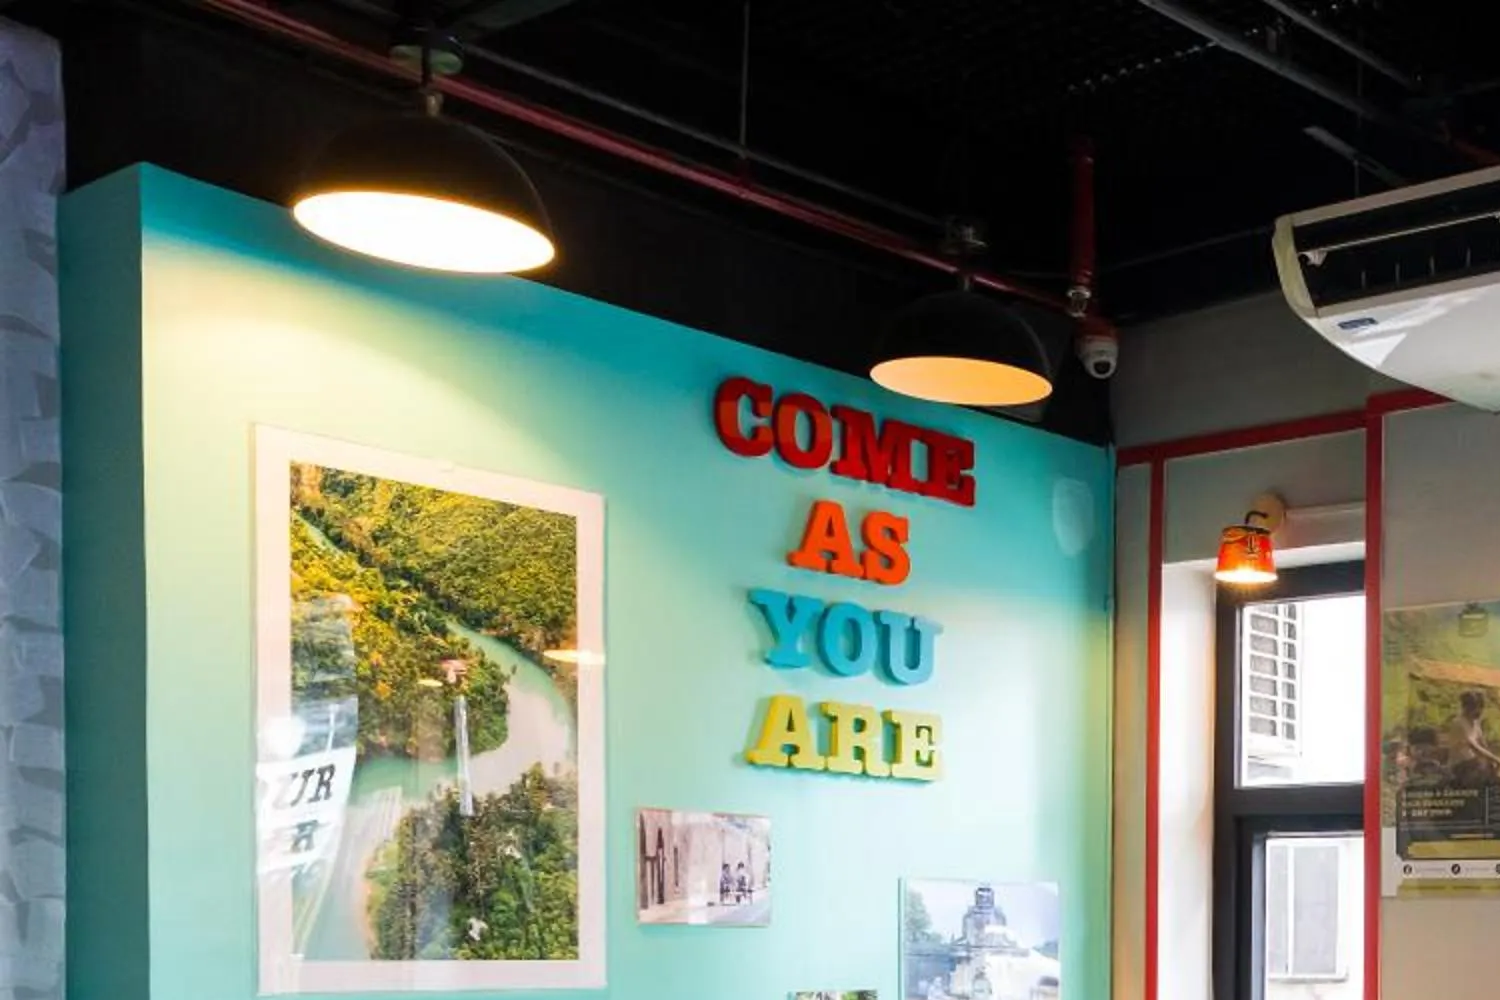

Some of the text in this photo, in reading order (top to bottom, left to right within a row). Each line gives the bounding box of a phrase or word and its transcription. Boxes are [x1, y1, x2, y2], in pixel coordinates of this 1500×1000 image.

[712, 377, 975, 507] COME
[786, 499, 911, 585] AS
[747, 588, 943, 685] YOU
[745, 694, 943, 782] ARE
